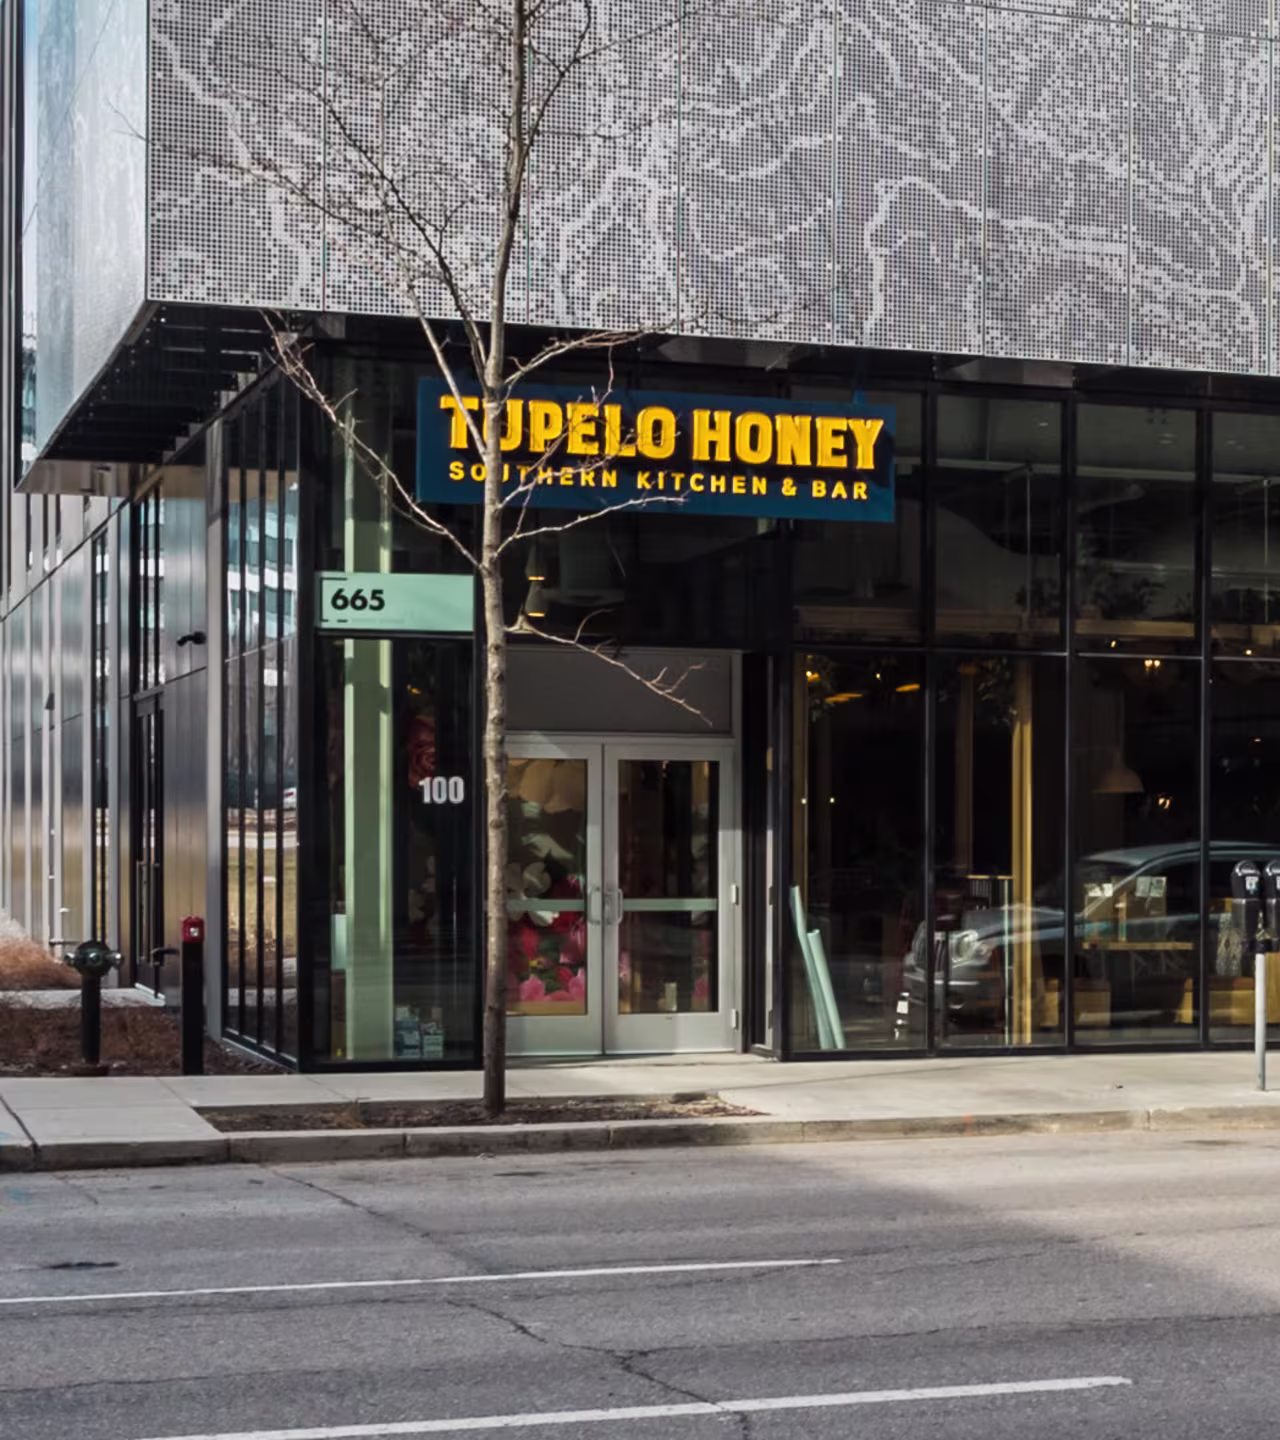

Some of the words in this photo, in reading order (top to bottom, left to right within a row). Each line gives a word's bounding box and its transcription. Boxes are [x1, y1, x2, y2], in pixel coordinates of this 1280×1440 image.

[440, 394, 676, 459] TUPELO
[692, 409, 884, 470] HONEY
[637, 470, 767, 495] KITCHEN
[782, 477, 797, 496] &
[812, 480, 867, 500] BAR
[331, 588, 385, 611] 665
[418, 776, 464, 804] 100
